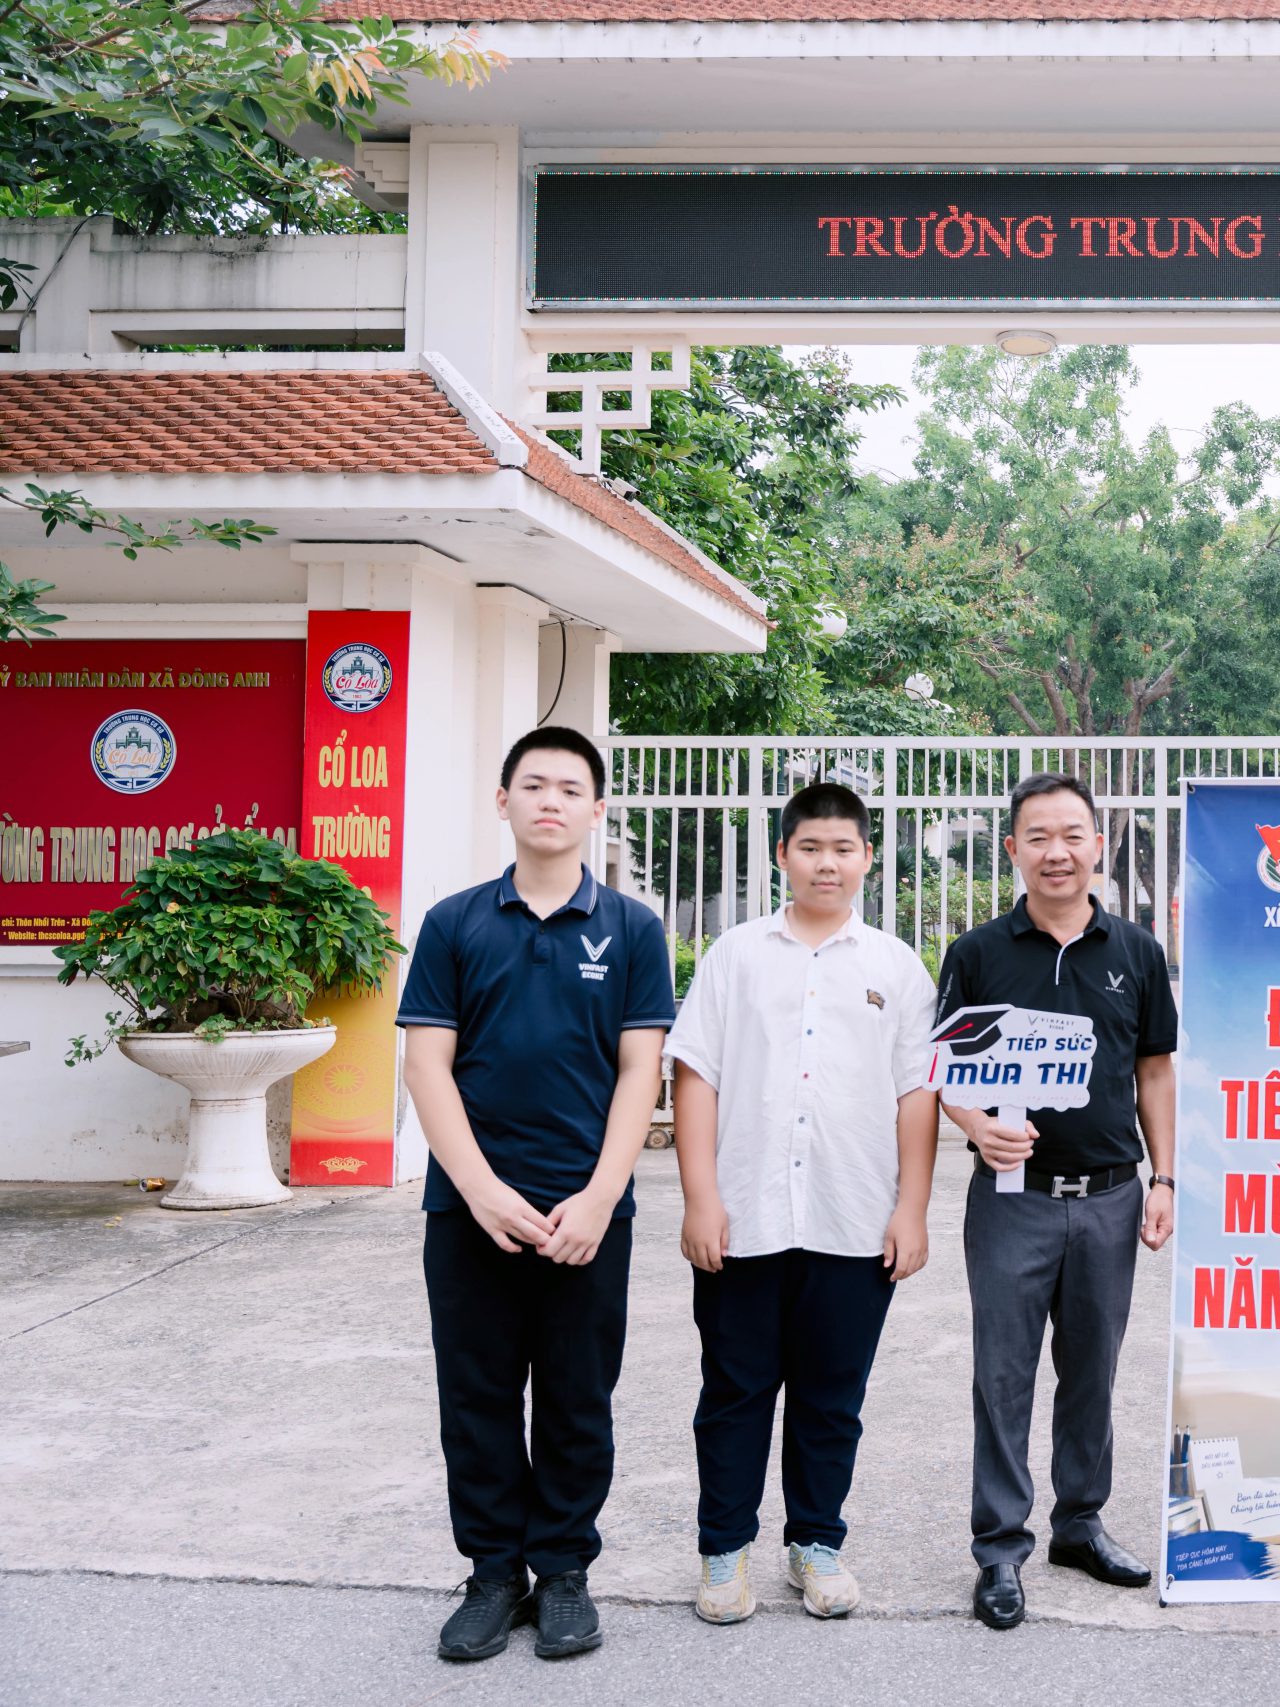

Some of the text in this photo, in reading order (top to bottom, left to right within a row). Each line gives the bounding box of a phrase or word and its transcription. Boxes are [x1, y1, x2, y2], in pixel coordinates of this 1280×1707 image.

[818, 205, 1057, 259] TRƯỜNG
[1070, 215, 1265, 259] TRUNG
[16, 672, 52, 687] BAN
[55, 667, 104, 687] NHÂN
[107, 666, 144, 687] DÂN
[148, 667, 174, 687] XÃ
[178, 667, 229, 687] ĐÔNG
[232, 672, 270, 687] ANH
[318, 729, 389, 788] CỔ LOA
[0, 812, 44, 883] ỜNG
[50, 826, 115, 883] TRUNG
[312, 805, 391, 858] TRƯỜNG
[8, 931, 37, 940] Website:
[1007, 1030, 1092, 1051] TIẾP SỨC
[946, 1055, 1087, 1085] MÙA THI
